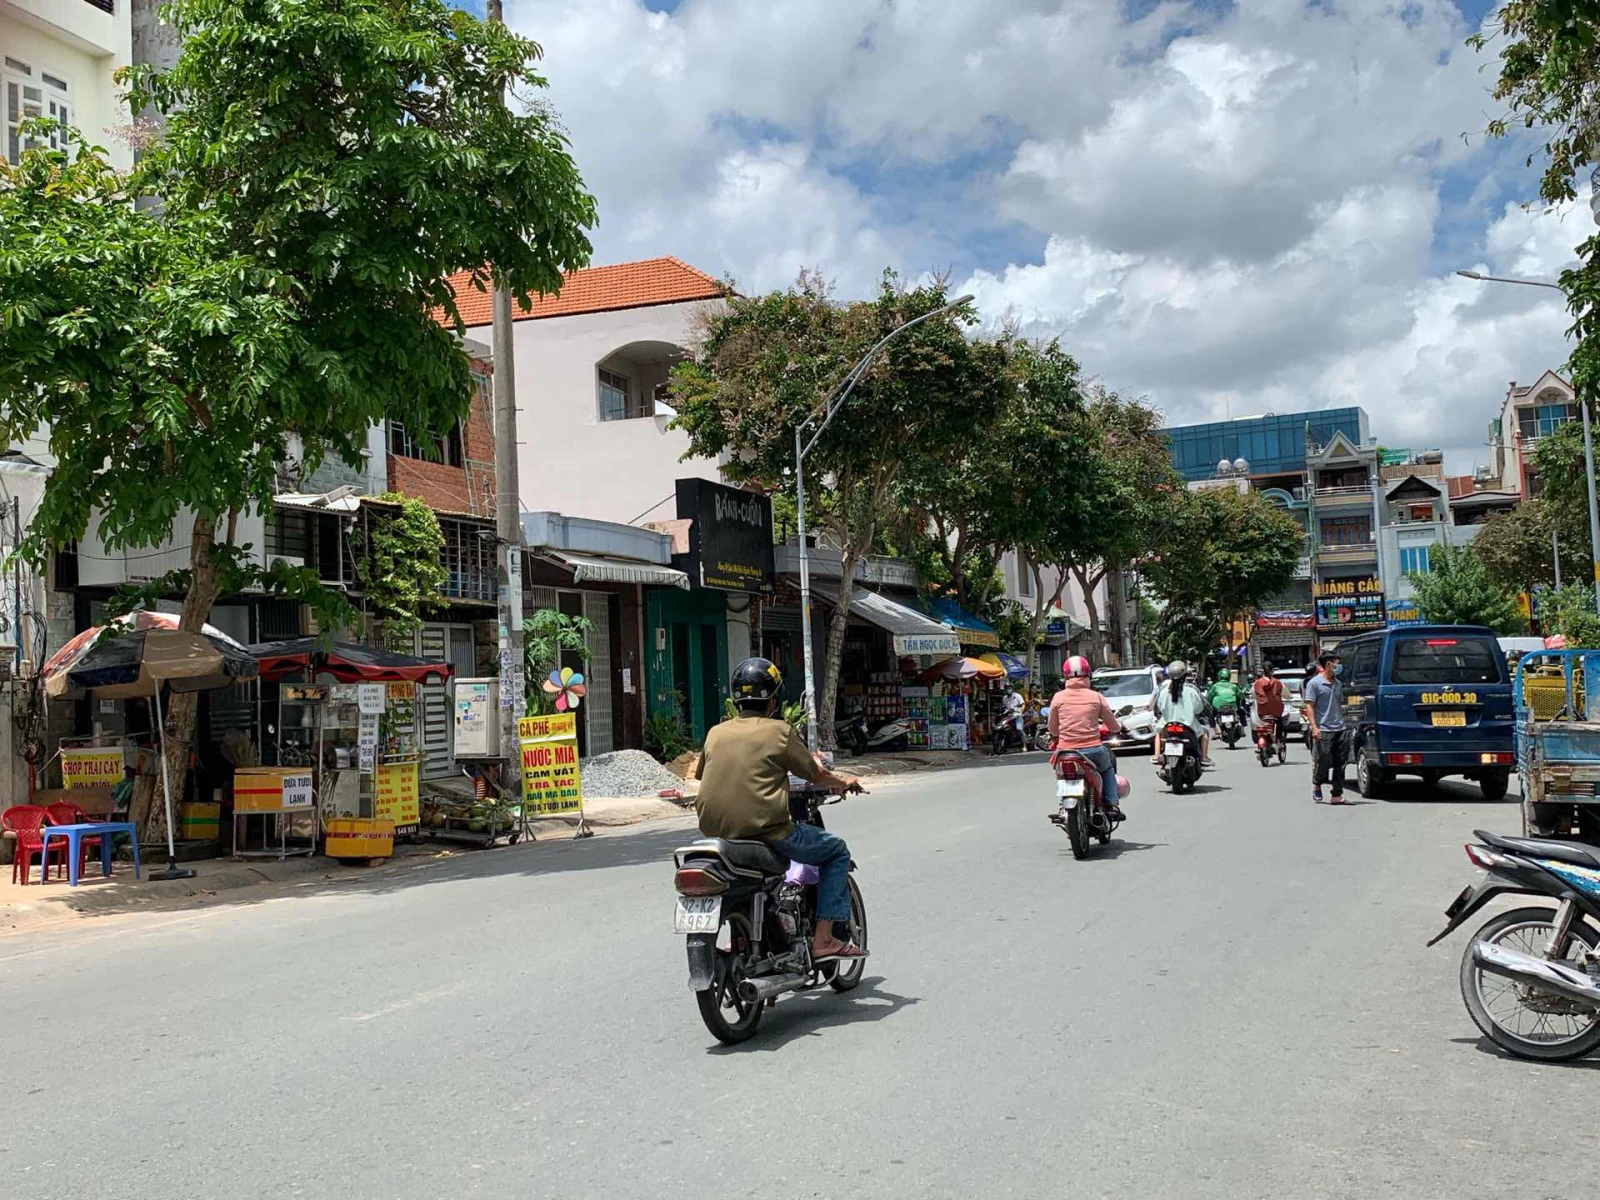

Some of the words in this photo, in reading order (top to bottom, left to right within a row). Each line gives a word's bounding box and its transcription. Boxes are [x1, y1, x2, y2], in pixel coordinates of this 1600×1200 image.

[1318, 607, 1352, 624] LED
[63, 761, 82, 775] SHOP
[525, 770, 550, 779] CAM
